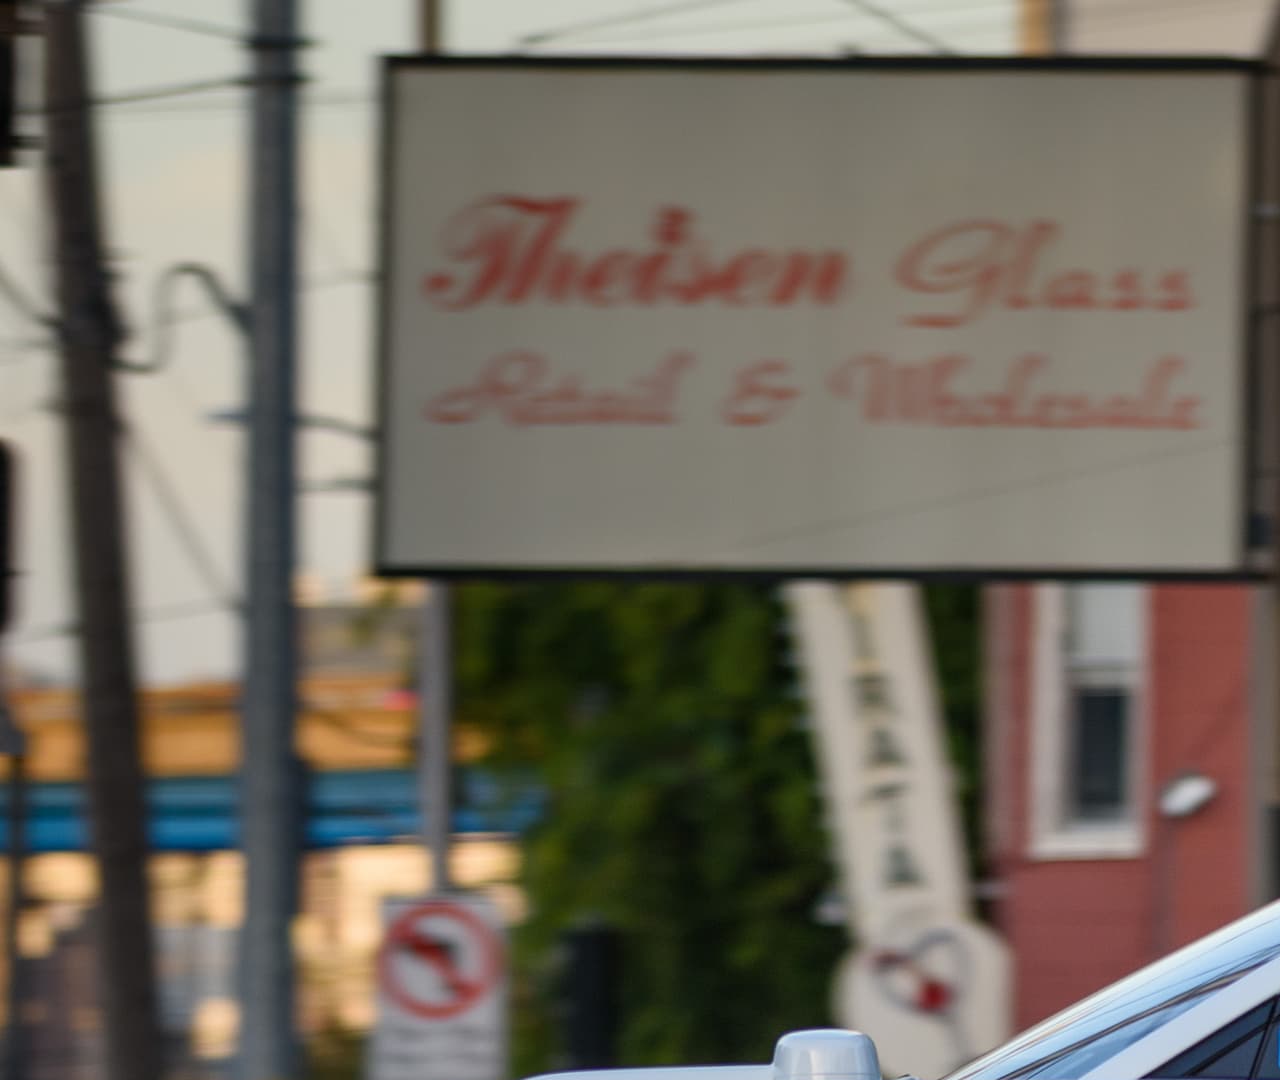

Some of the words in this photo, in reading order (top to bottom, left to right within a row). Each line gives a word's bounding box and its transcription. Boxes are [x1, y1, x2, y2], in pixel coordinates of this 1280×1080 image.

[420, 194, 850, 310] Theisen
[893, 219, 1196, 328] Glass
[422, 349, 698, 428] Retail
[722, 358, 800, 427] &
[826, 352, 1204, 430] Wholesale
